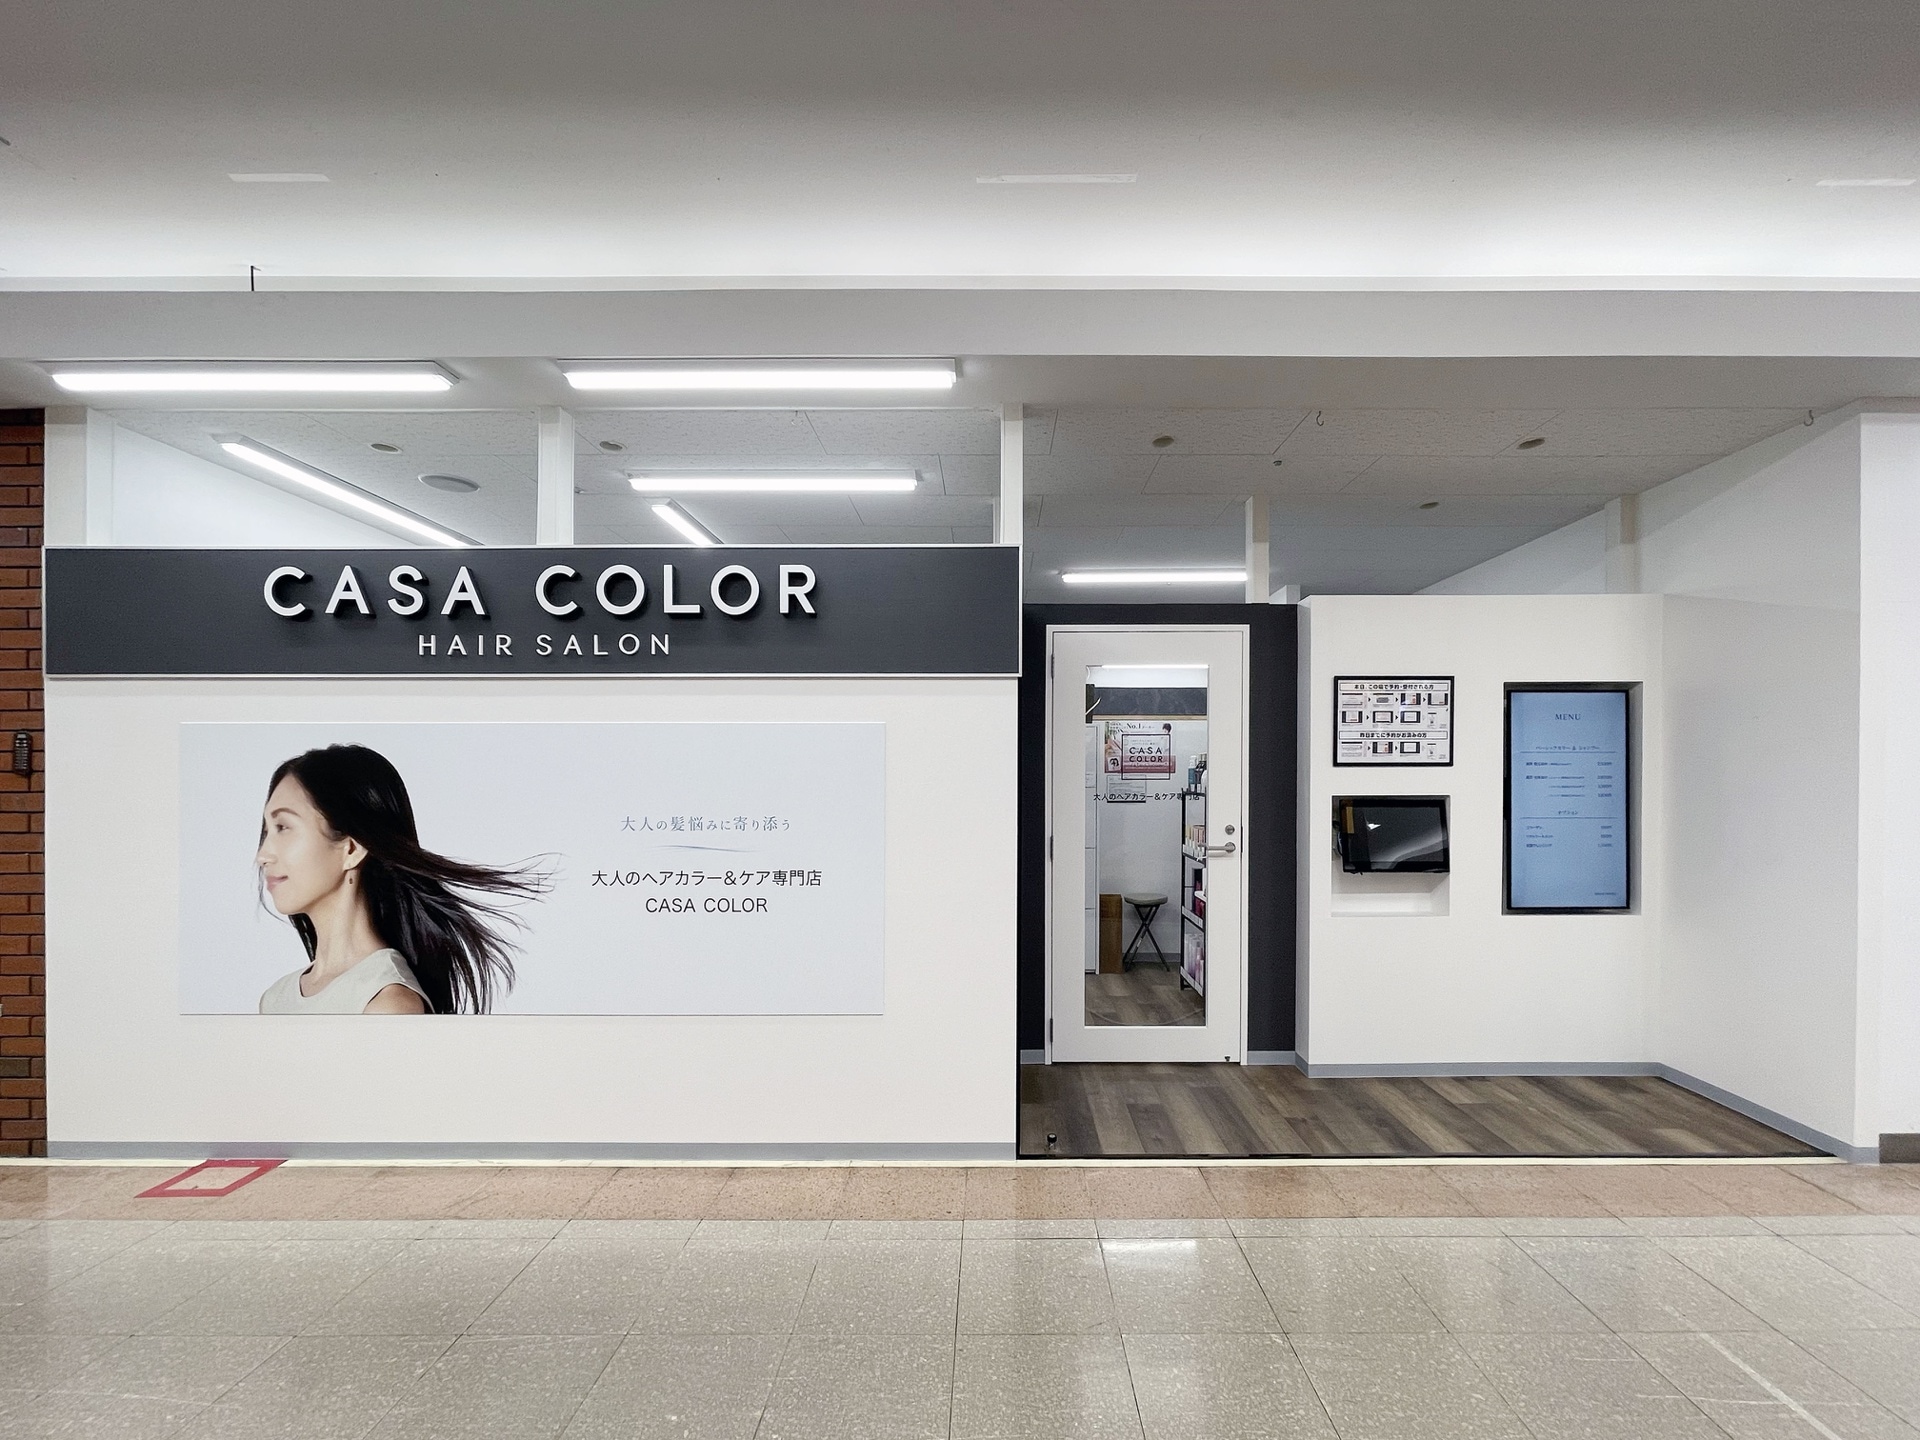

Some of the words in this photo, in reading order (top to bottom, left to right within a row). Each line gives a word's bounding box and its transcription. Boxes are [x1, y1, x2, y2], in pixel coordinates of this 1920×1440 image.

[264, 565, 486, 616] CASA
[535, 564, 817, 616] COLOR
[418, 634, 513, 656] HAIR
[536, 634, 671, 656] SALON
[1555, 713, 1581, 721] MENU
[1129, 747, 1162, 755] CASA
[621, 815, 791, 832] 大人の髪悩みに寄り添う
[592, 869, 822, 887] 大人のヘアカラー&ケア専門店
[645, 898, 696, 913] CASA
[703, 898, 768, 913] COLOR
